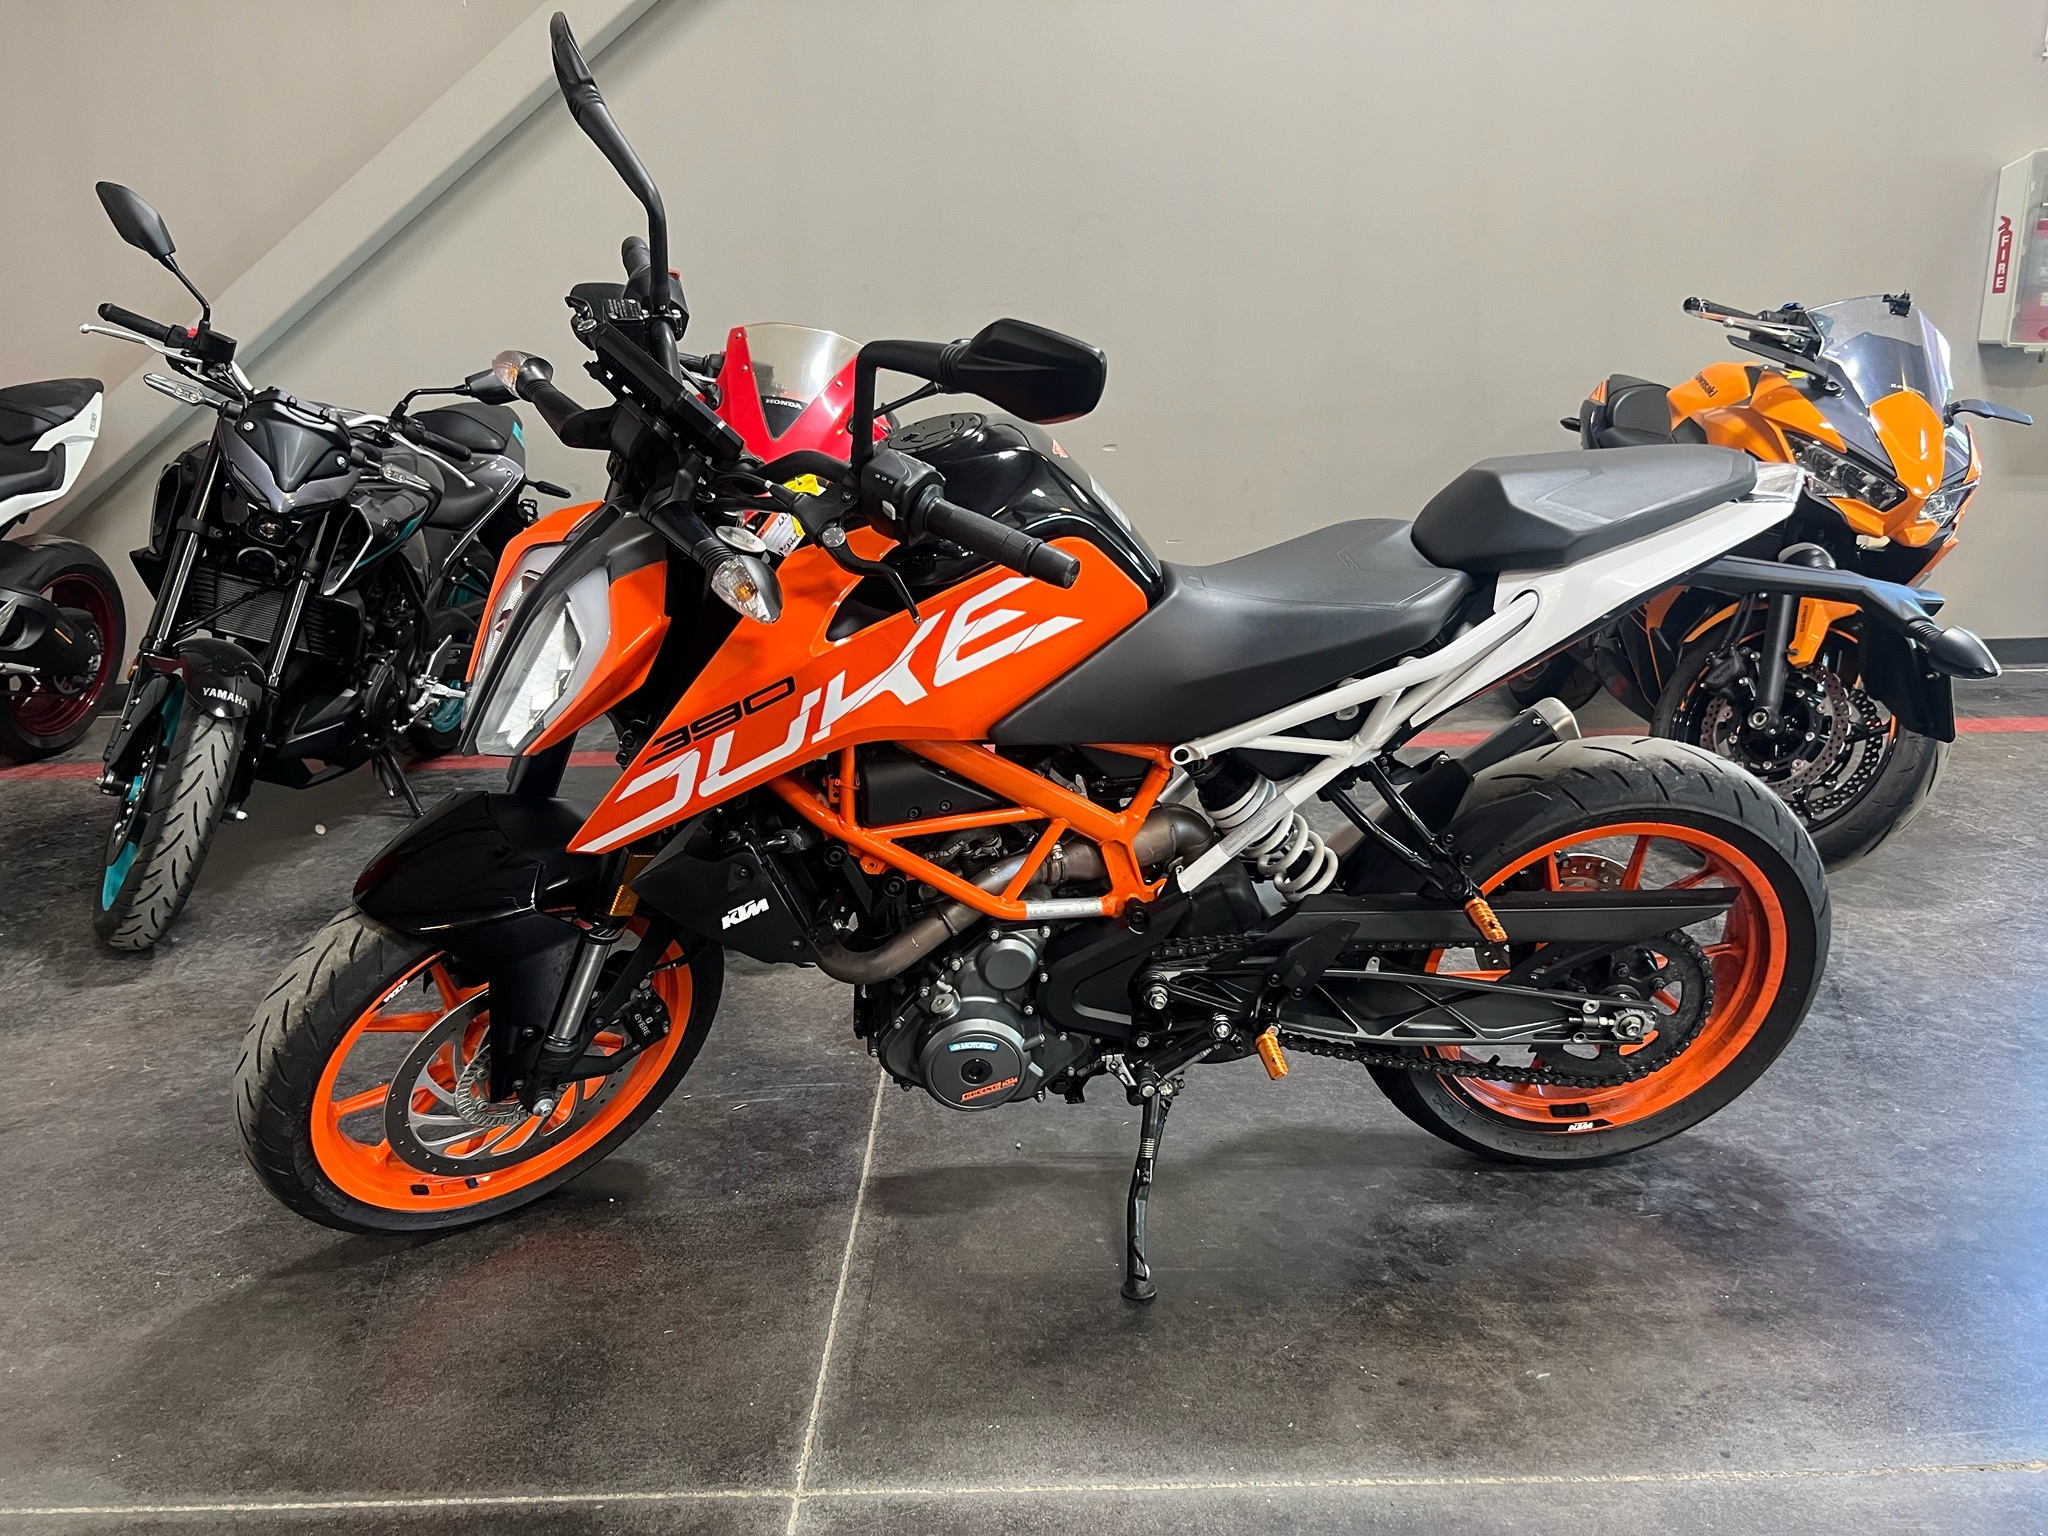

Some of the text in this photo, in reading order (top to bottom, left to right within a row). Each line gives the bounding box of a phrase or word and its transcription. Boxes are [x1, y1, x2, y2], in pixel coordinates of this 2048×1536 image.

[1995, 235, 2010, 289] FIRE
[765, 399, 803, 410] HONDA
[202, 687, 248, 709] YAMAHA
[575, 577, 1084, 853] DUKE
[641, 675, 797, 767] 390
[721, 898, 770, 930] KTM
[1567, 1121, 1594, 1132] KTM
